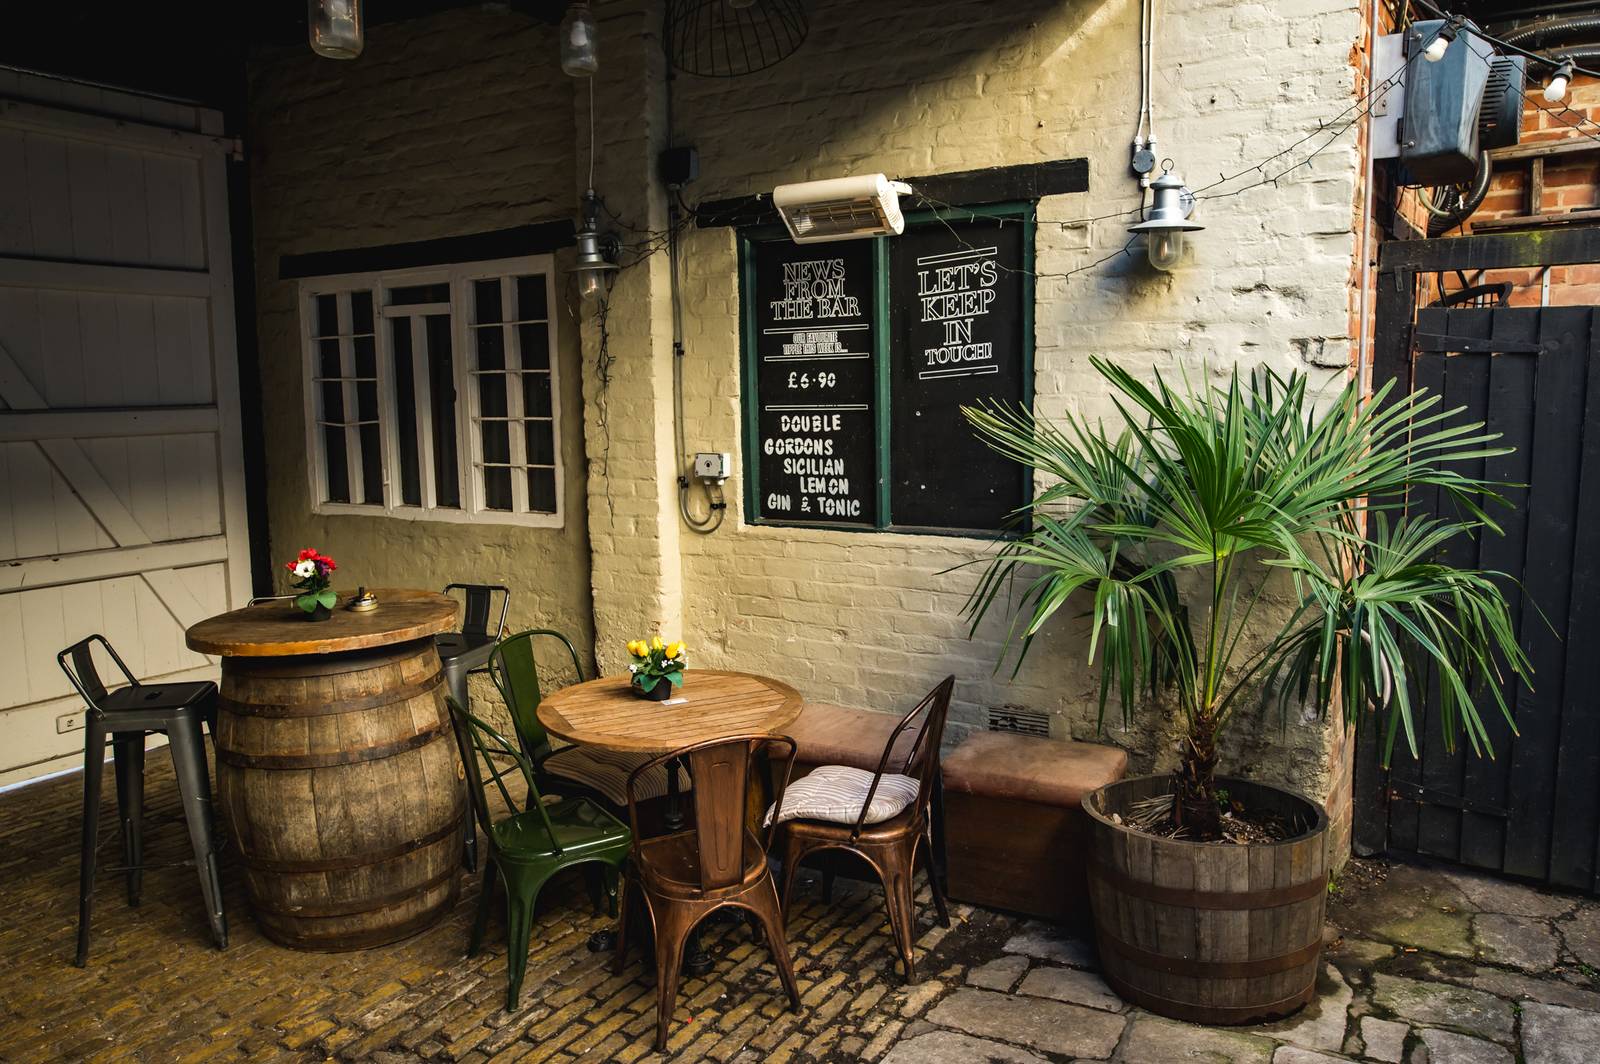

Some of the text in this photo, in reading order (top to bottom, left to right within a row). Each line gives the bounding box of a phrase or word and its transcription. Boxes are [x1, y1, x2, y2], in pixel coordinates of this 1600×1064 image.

[782, 259, 845, 281] NEWS
[917, 261, 998, 296] LET'S
[783, 278, 846, 301] FROM
[770, 296, 861, 320] THE BAR
[920, 289, 996, 322] KEEP
[943, 318, 974, 346] IN
[924, 342, 993, 366] TOUCH!
[781, 414, 841, 432] DOUBLE
[764, 438, 834, 455] GORDONS
[783, 457, 844, 476] SICILIAN
[800, 476, 849, 495] LEMON
[767, 492, 860, 517] GIN & TONIC
